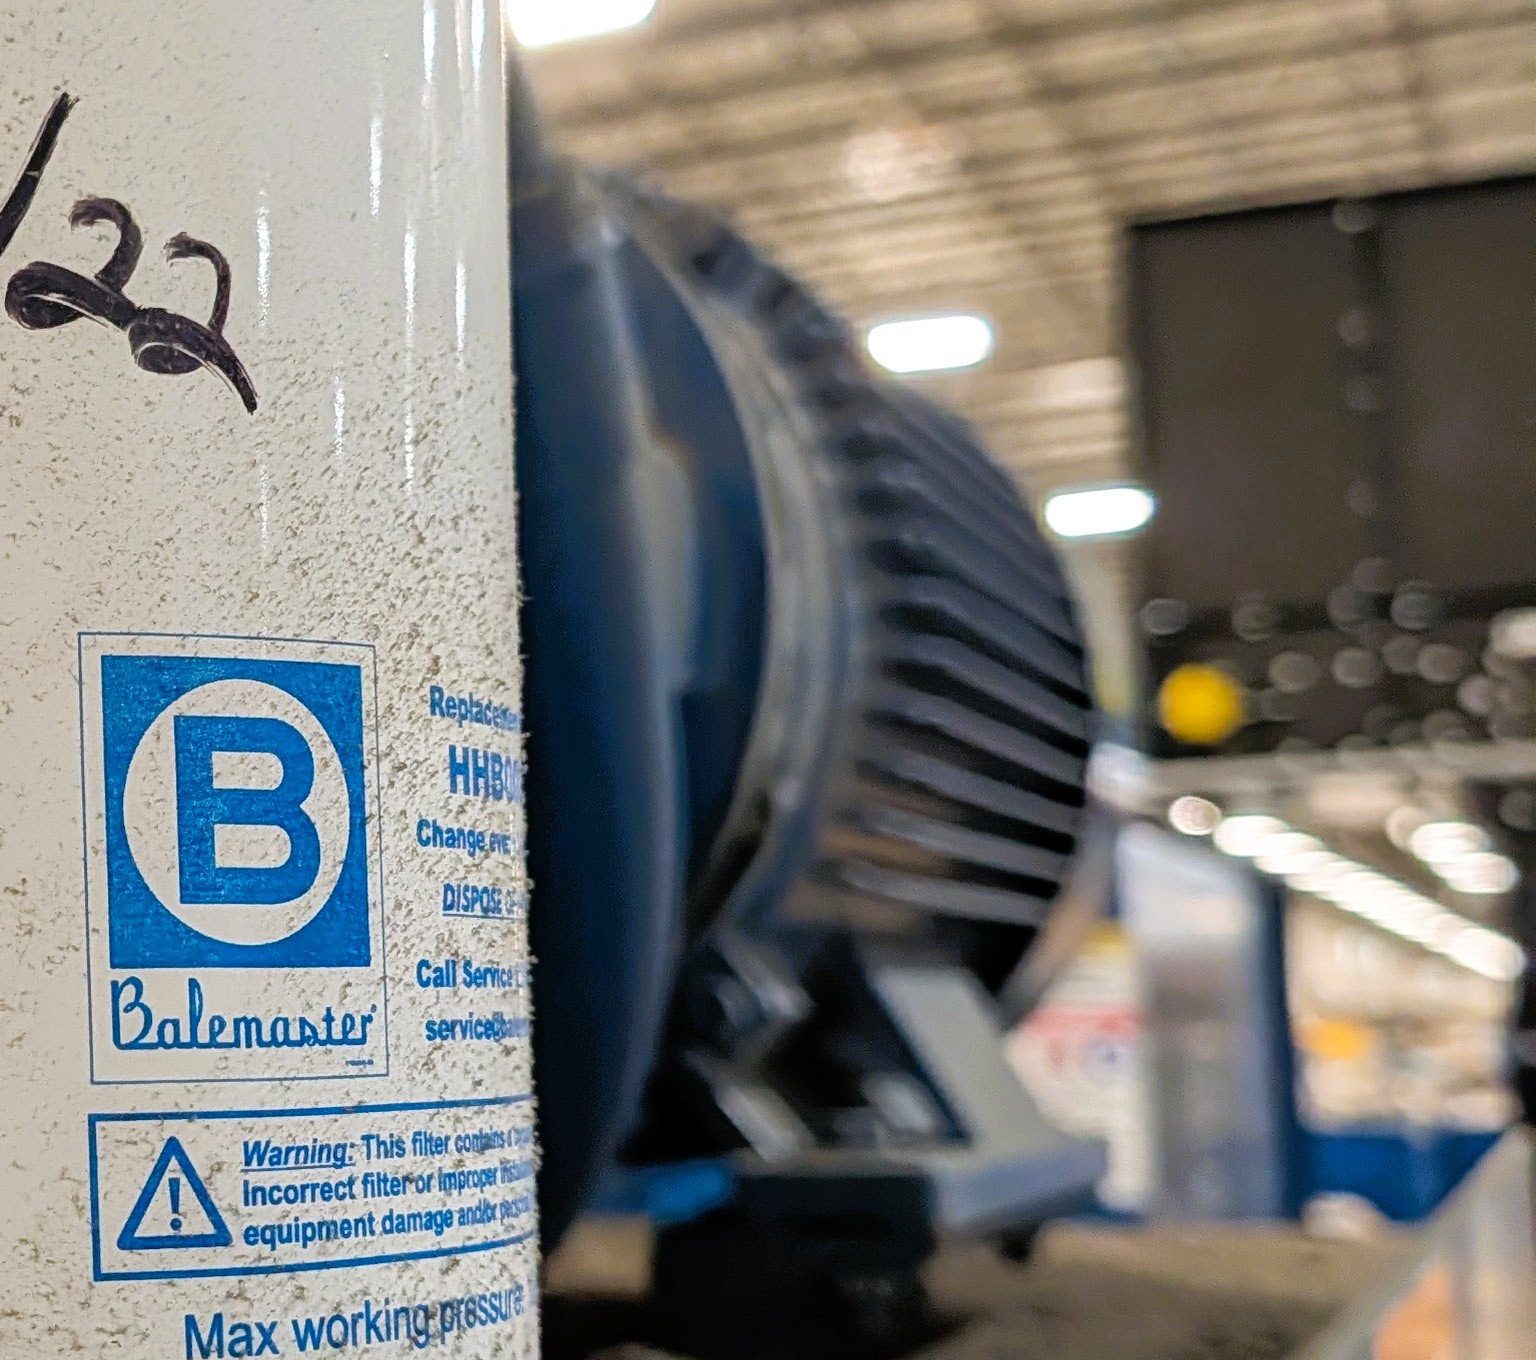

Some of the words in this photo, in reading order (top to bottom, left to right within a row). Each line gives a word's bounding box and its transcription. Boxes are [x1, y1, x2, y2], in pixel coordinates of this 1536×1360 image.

[173, 714, 322, 905] B
[416, 818, 485, 857] Change
[442, 882, 502, 916] DISPOSE
[416, 958, 457, 988] Call
[462, 959, 513, 989] Service
[110, 976, 375, 1051] Balemaster
[242, 1137, 356, 1172] Warning:
[360, 1132, 407, 1161] This
[411, 1129, 451, 1157] filter
[454, 1125, 505, 1153] contains
[242, 1173, 356, 1207] Incorrect
[361, 1169, 409, 1199] filter
[414, 1171, 435, 1195] or
[437, 1165, 498, 1195] improper
[243, 1210, 376, 1251] equipment
[381, 1206, 454, 1237] damage
[457, 1197, 498, 1227] and/or
[292, 1296, 430, 1351] working
[439, 1281, 524, 1346] pressure
